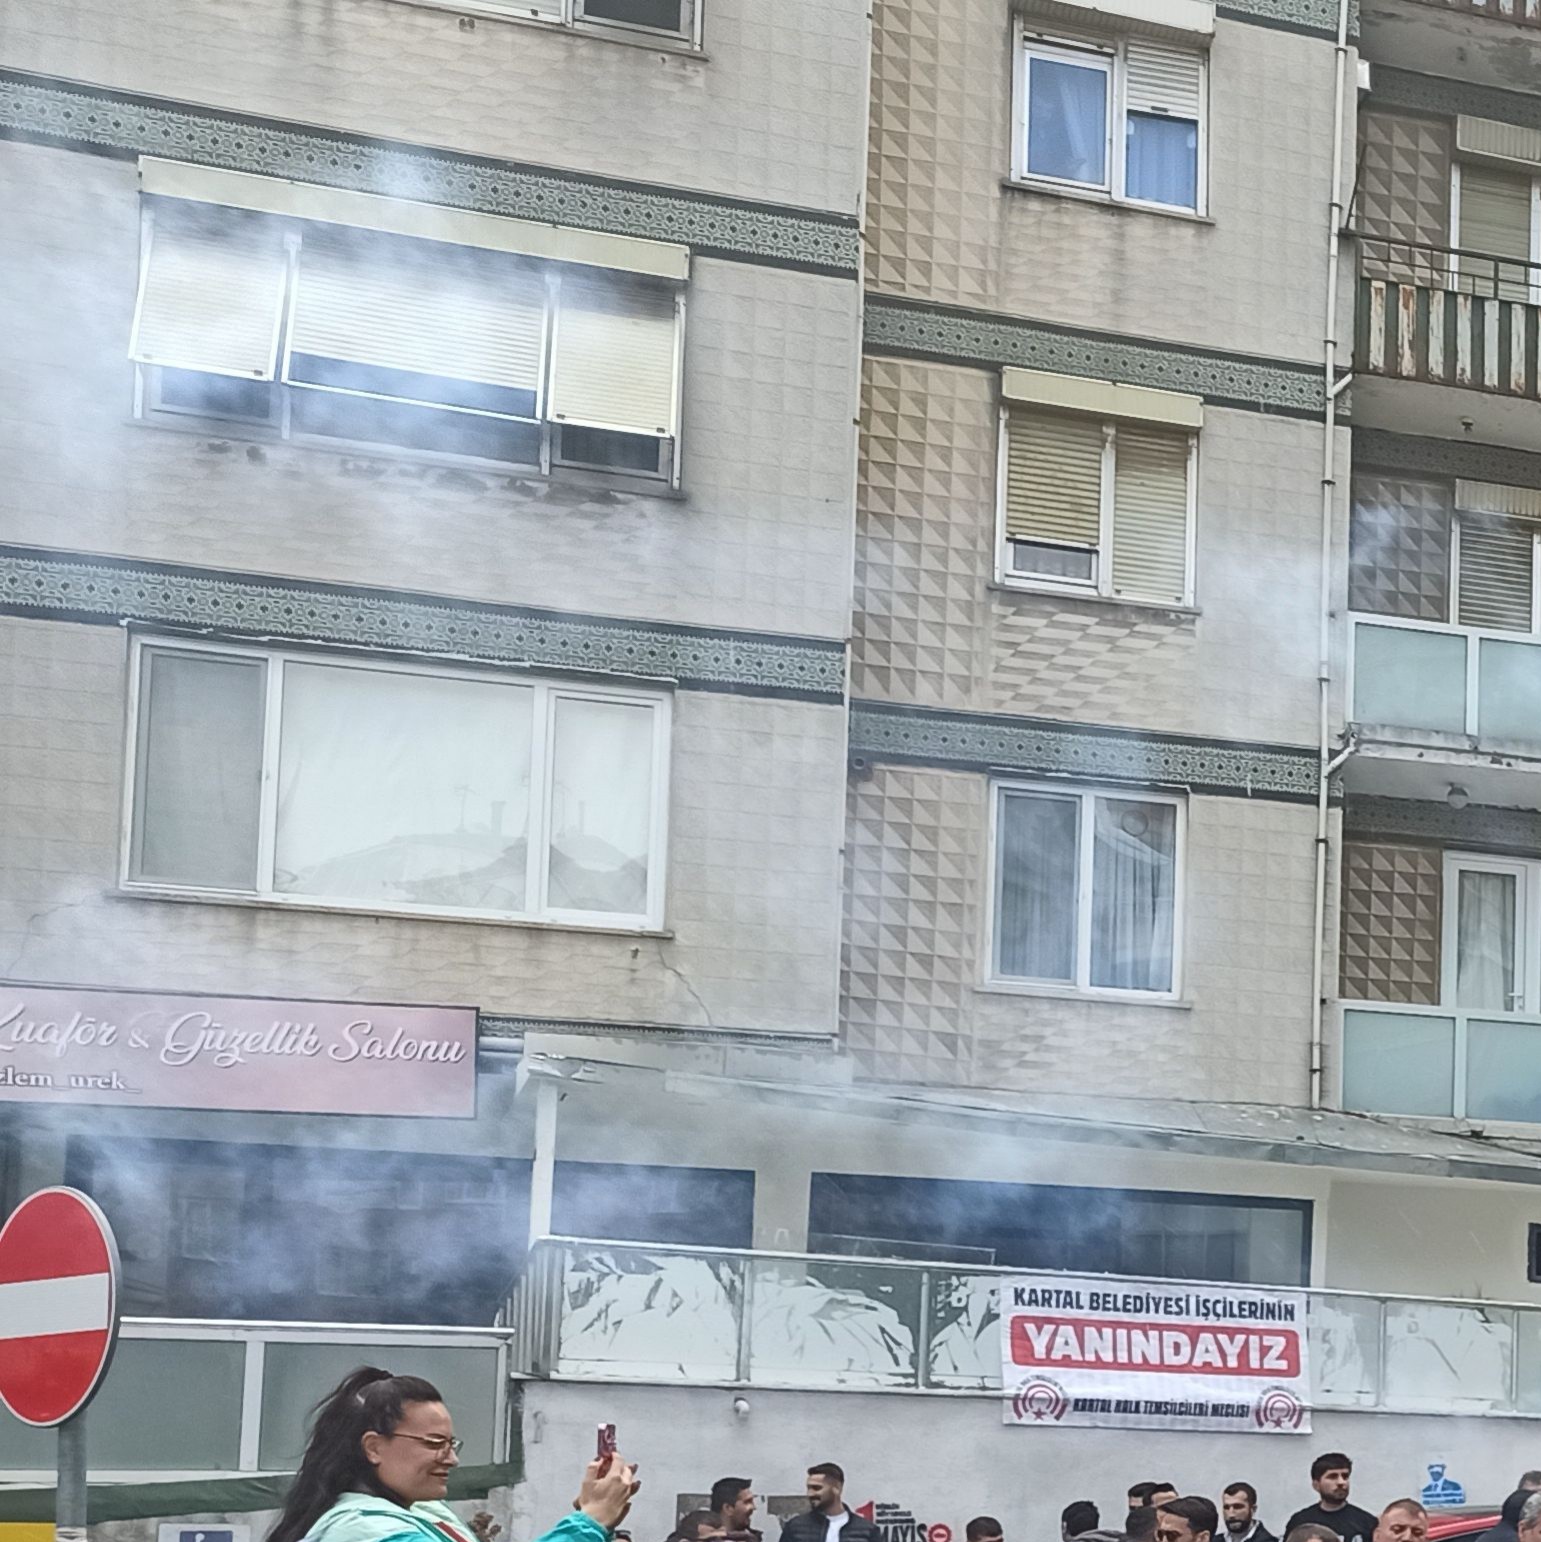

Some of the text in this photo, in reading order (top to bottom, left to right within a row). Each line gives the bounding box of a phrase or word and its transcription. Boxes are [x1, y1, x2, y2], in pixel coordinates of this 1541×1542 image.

[128, 1027, 151, 1050] &
[160, 1011, 324, 1068] Güzellik
[327, 1020, 467, 1064] Salonu
[1013, 1287, 1295, 1322] KARTAL BELEDİYESİ İŞÇİLERİNİN
[1024, 1322, 1288, 1371] YANINDAYIZ
[1073, 1398, 1112, 1414] KARTAL
